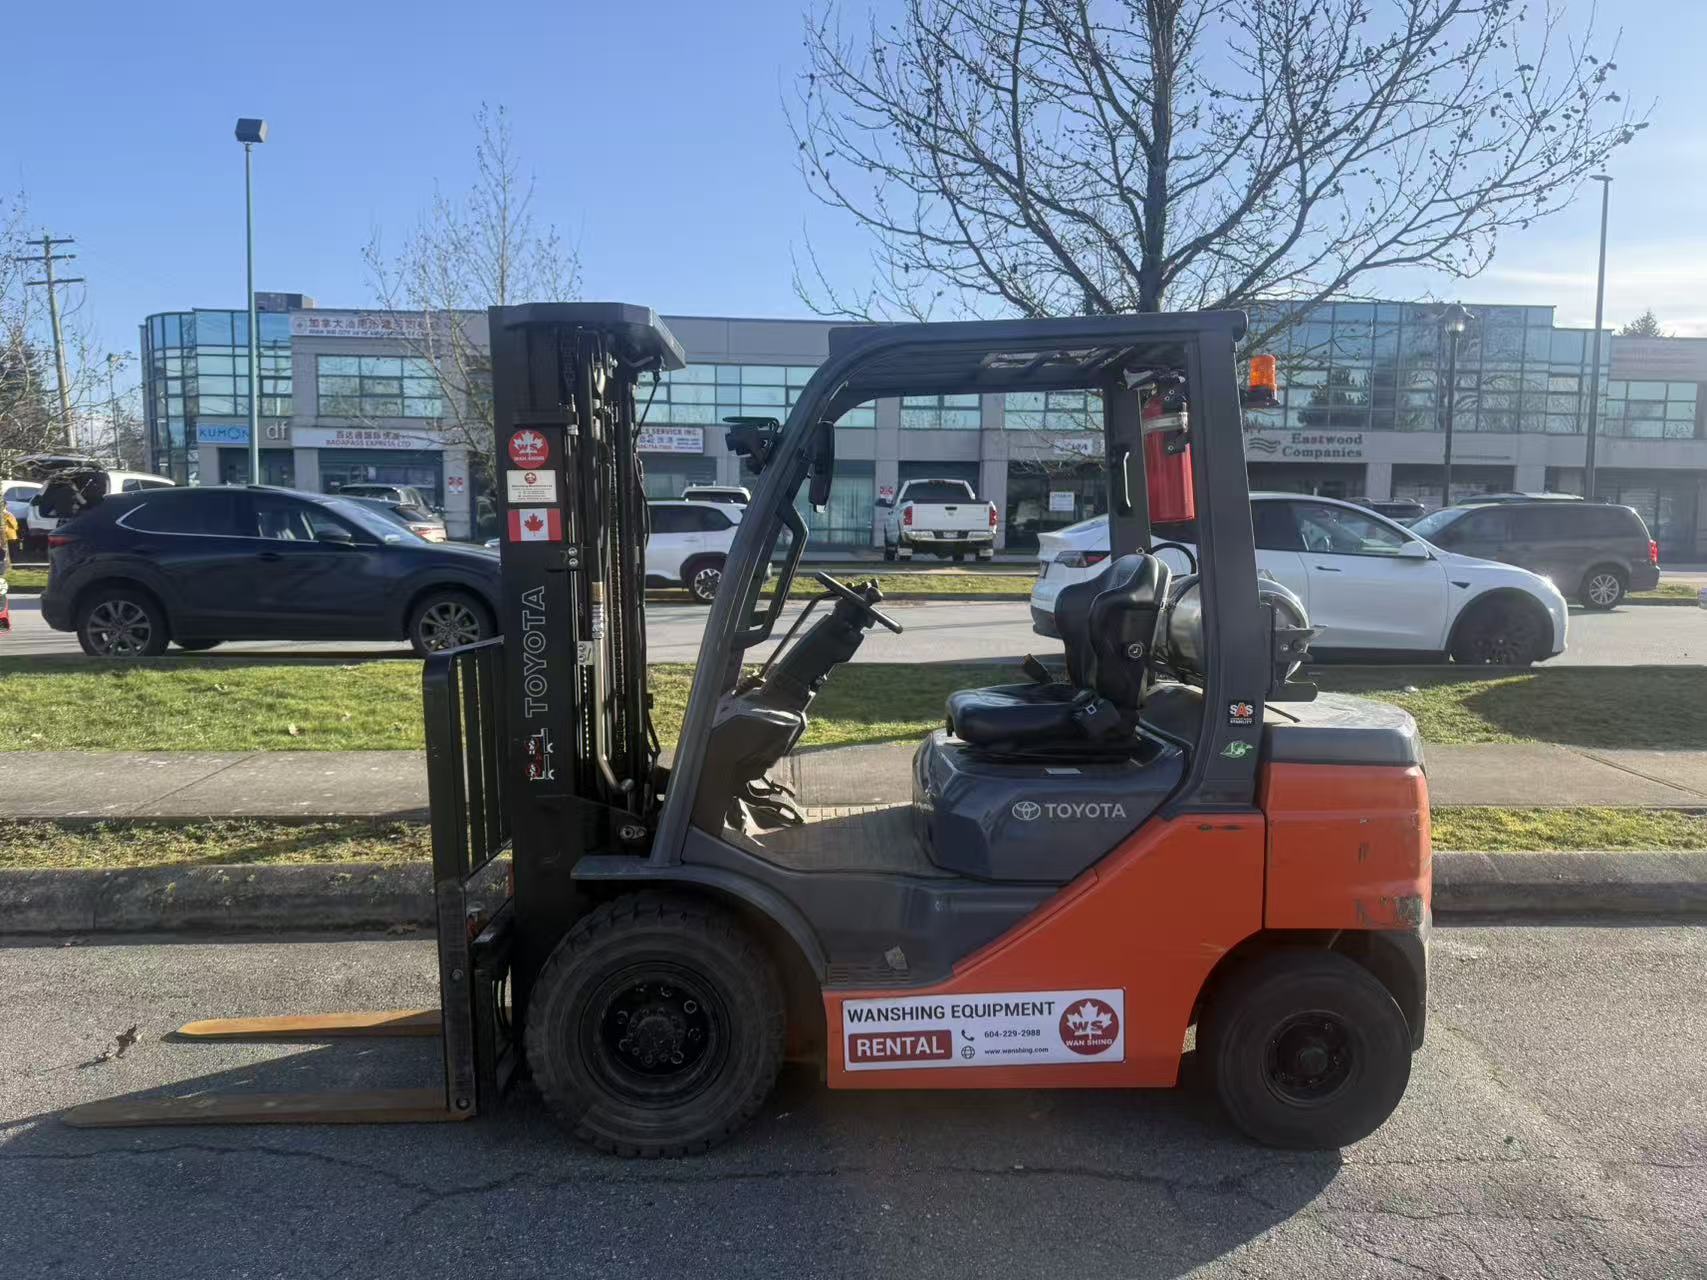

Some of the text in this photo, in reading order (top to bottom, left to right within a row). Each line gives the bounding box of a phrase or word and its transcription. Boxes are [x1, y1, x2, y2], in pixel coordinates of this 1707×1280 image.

[200, 426, 249, 439] KUMON
[1291, 432, 1363, 445] Eastwood
[1282, 448, 1362, 460] Companies
[522, 585, 548, 718] TOYOTA
[1230, 702, 1253, 717] SAS
[1045, 803, 1126, 818] TOYOTA
[847, 1001, 1056, 1023] WANSHING EQUIPMENT
[1072, 1020, 1104, 1032] WS
[984, 1028, 1041, 1039] 604-229-2988
[856, 1036, 945, 1057] RENTAL
[1066, 1038, 1113, 1047] WAN SHING
[984, 1046, 1049, 1056] www.wanshing.com
